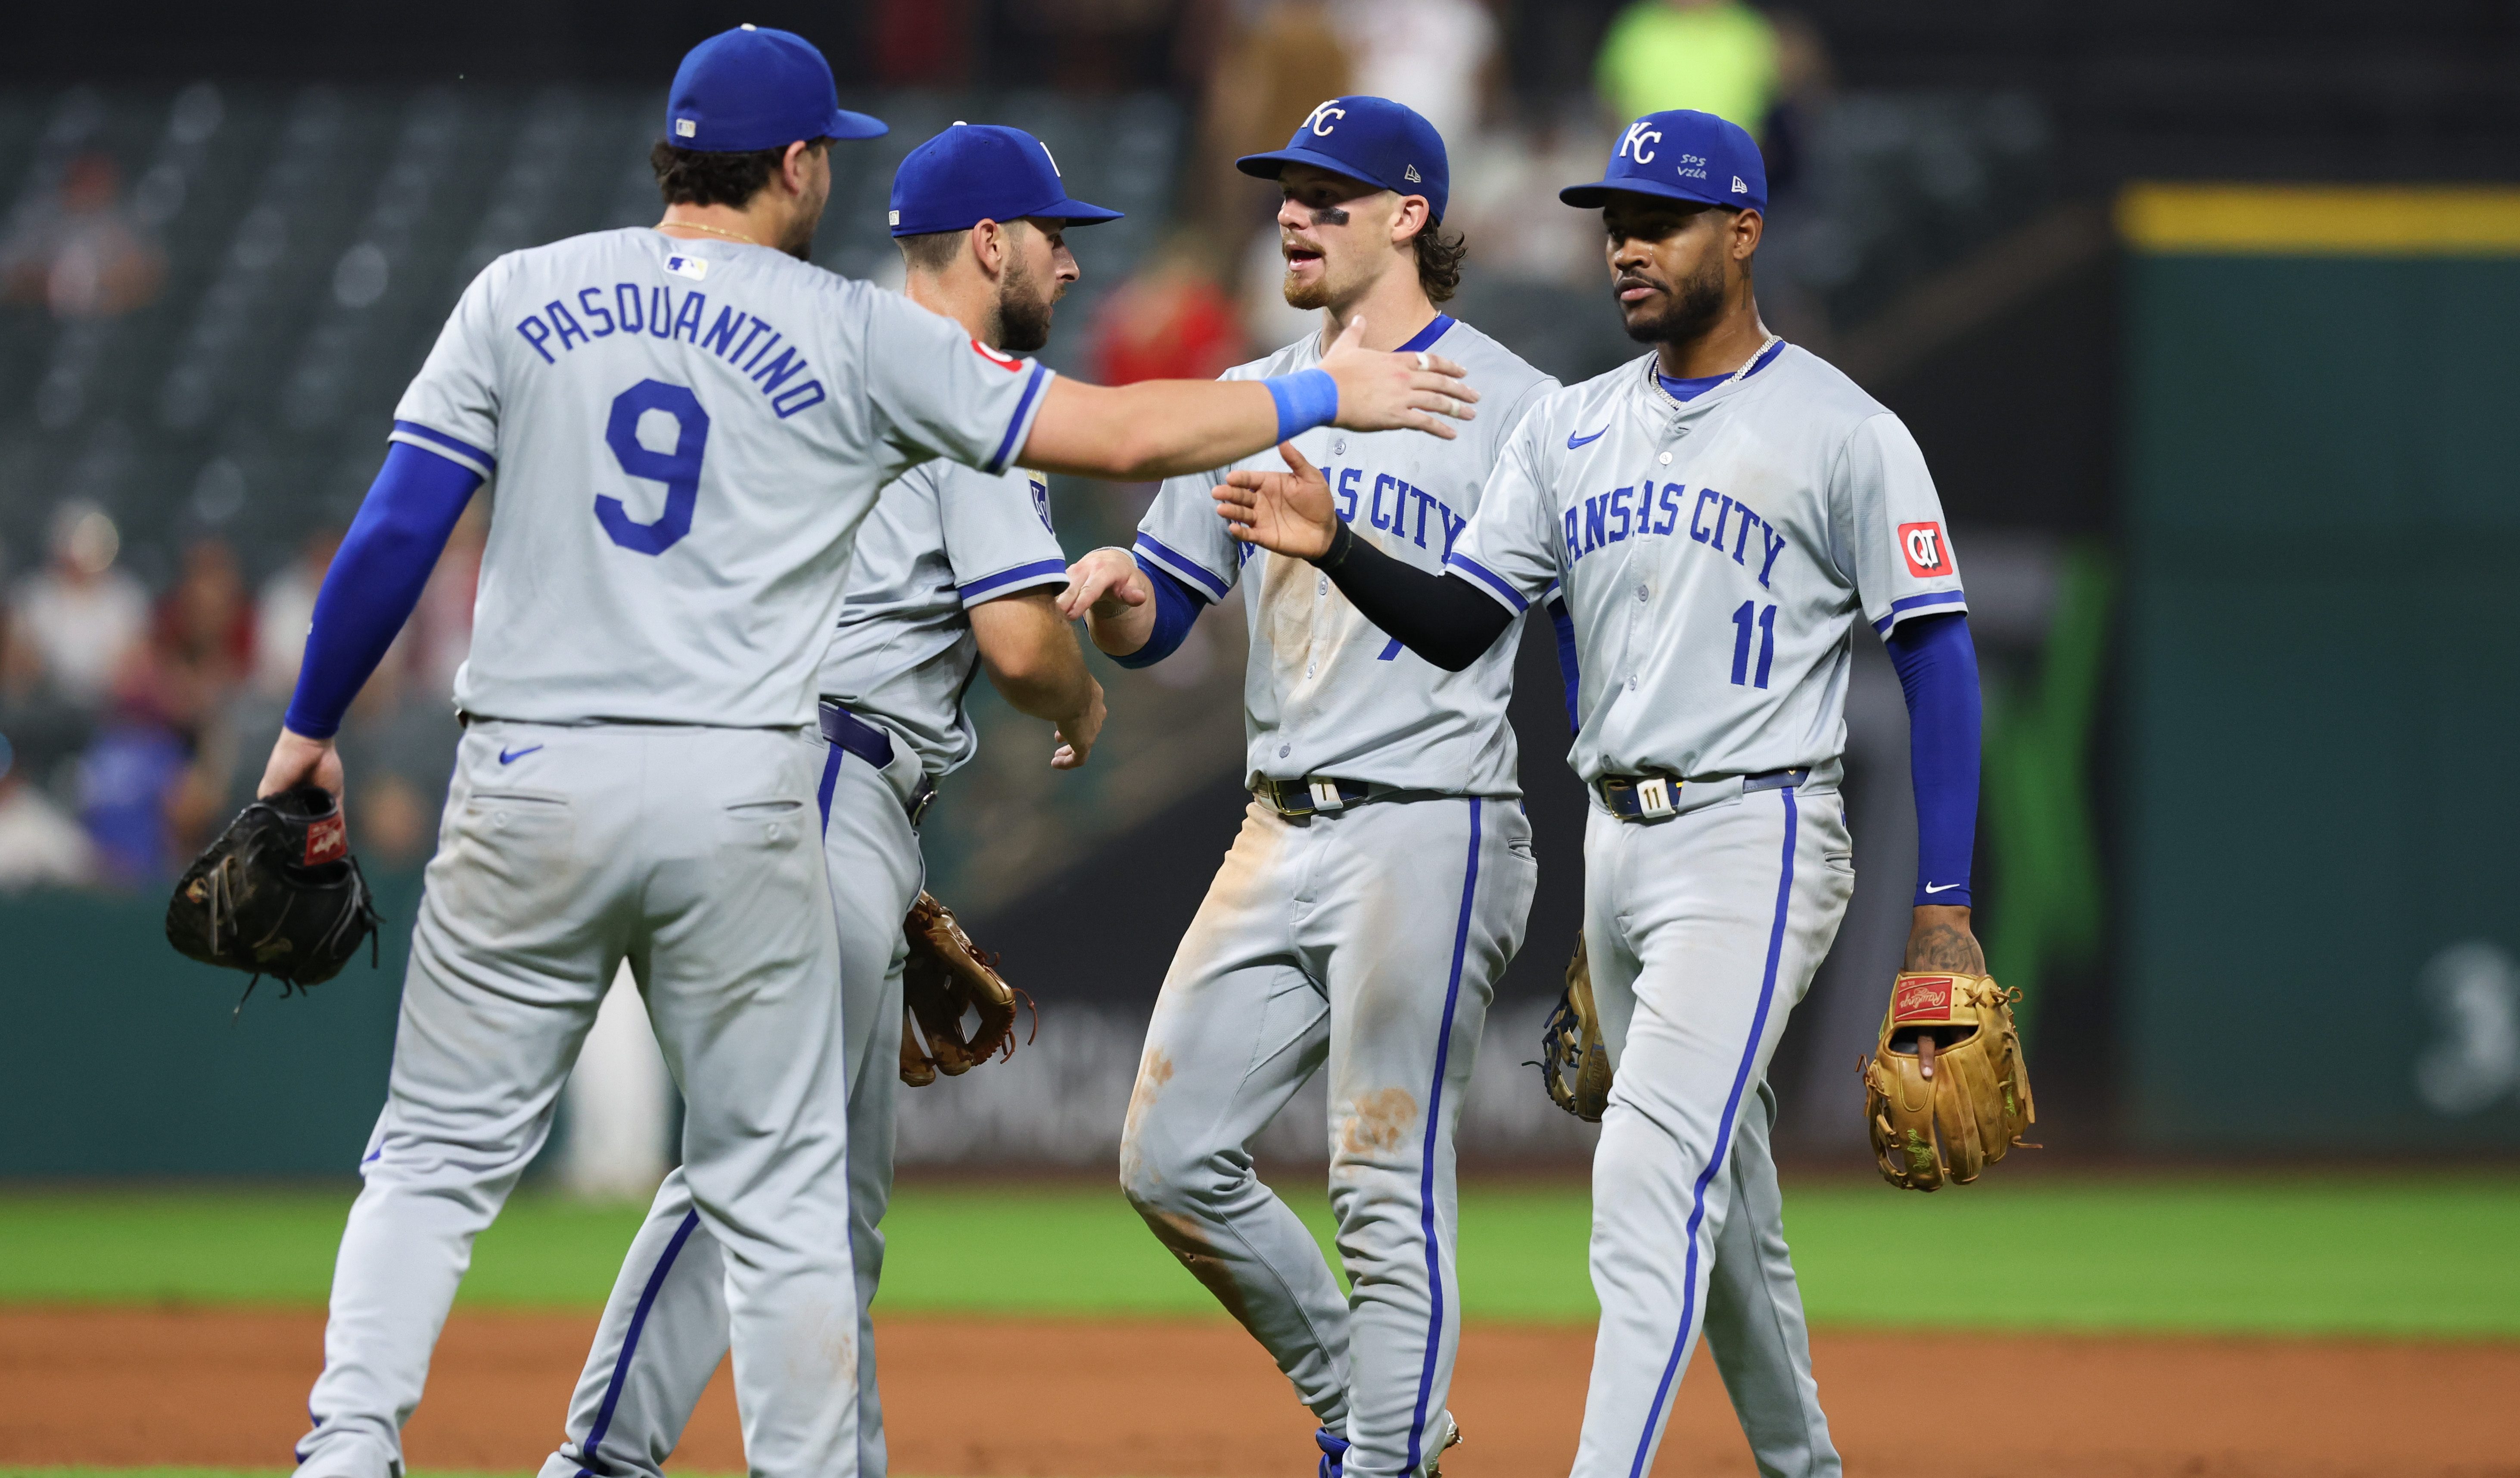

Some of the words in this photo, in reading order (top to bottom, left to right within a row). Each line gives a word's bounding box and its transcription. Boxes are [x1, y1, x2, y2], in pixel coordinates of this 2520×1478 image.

[1300, 99, 1346, 137] KC
[1619, 122, 1662, 165] KC
[1680, 153, 1706, 167] SOS
[516, 283, 826, 419] PASQUANTINO
[594, 378, 710, 556] 9
[1371, 472, 1467, 565] CITY
[1564, 479, 1686, 573] ANSAS
[1689, 487, 1786, 590] CITY
[1907, 528, 1941, 570] QT
[1730, 600, 1777, 689] 11
[1643, 787, 1661, 810] 11
